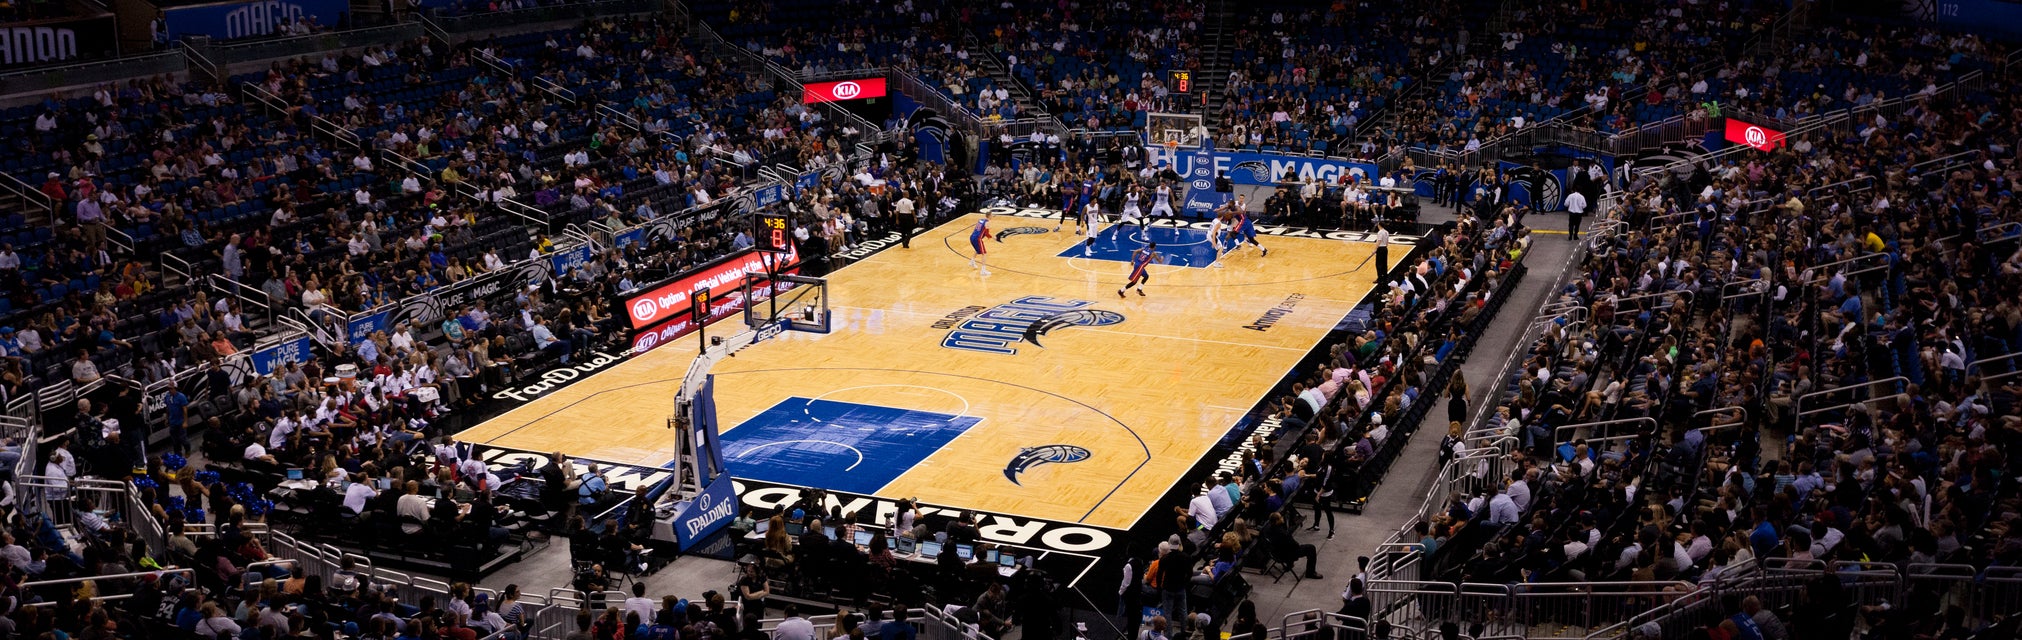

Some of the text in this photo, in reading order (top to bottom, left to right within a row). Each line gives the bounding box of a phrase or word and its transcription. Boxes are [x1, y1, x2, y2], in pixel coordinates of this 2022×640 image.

[1943, 3, 1958, 17] 112
[835, 83, 858, 97] KIA
[1180, 80, 1187, 92] 8
[1194, 180, 1209, 189] KIA
[1189, 198, 1213, 209] Amway
[763, 217, 785, 230] 4:36
[772, 229, 783, 248] 8
[442, 280, 501, 309] PURE MAGIC
[634, 300, 656, 319] KIA
[658, 290, 687, 309] Optima
[718, 264, 742, 284] Vehicle
[701, 303, 706, 313] 8
[757, 323, 783, 341] GEICO
[276, 341, 300, 358] PURE
[686, 496, 734, 540] SPALDING
